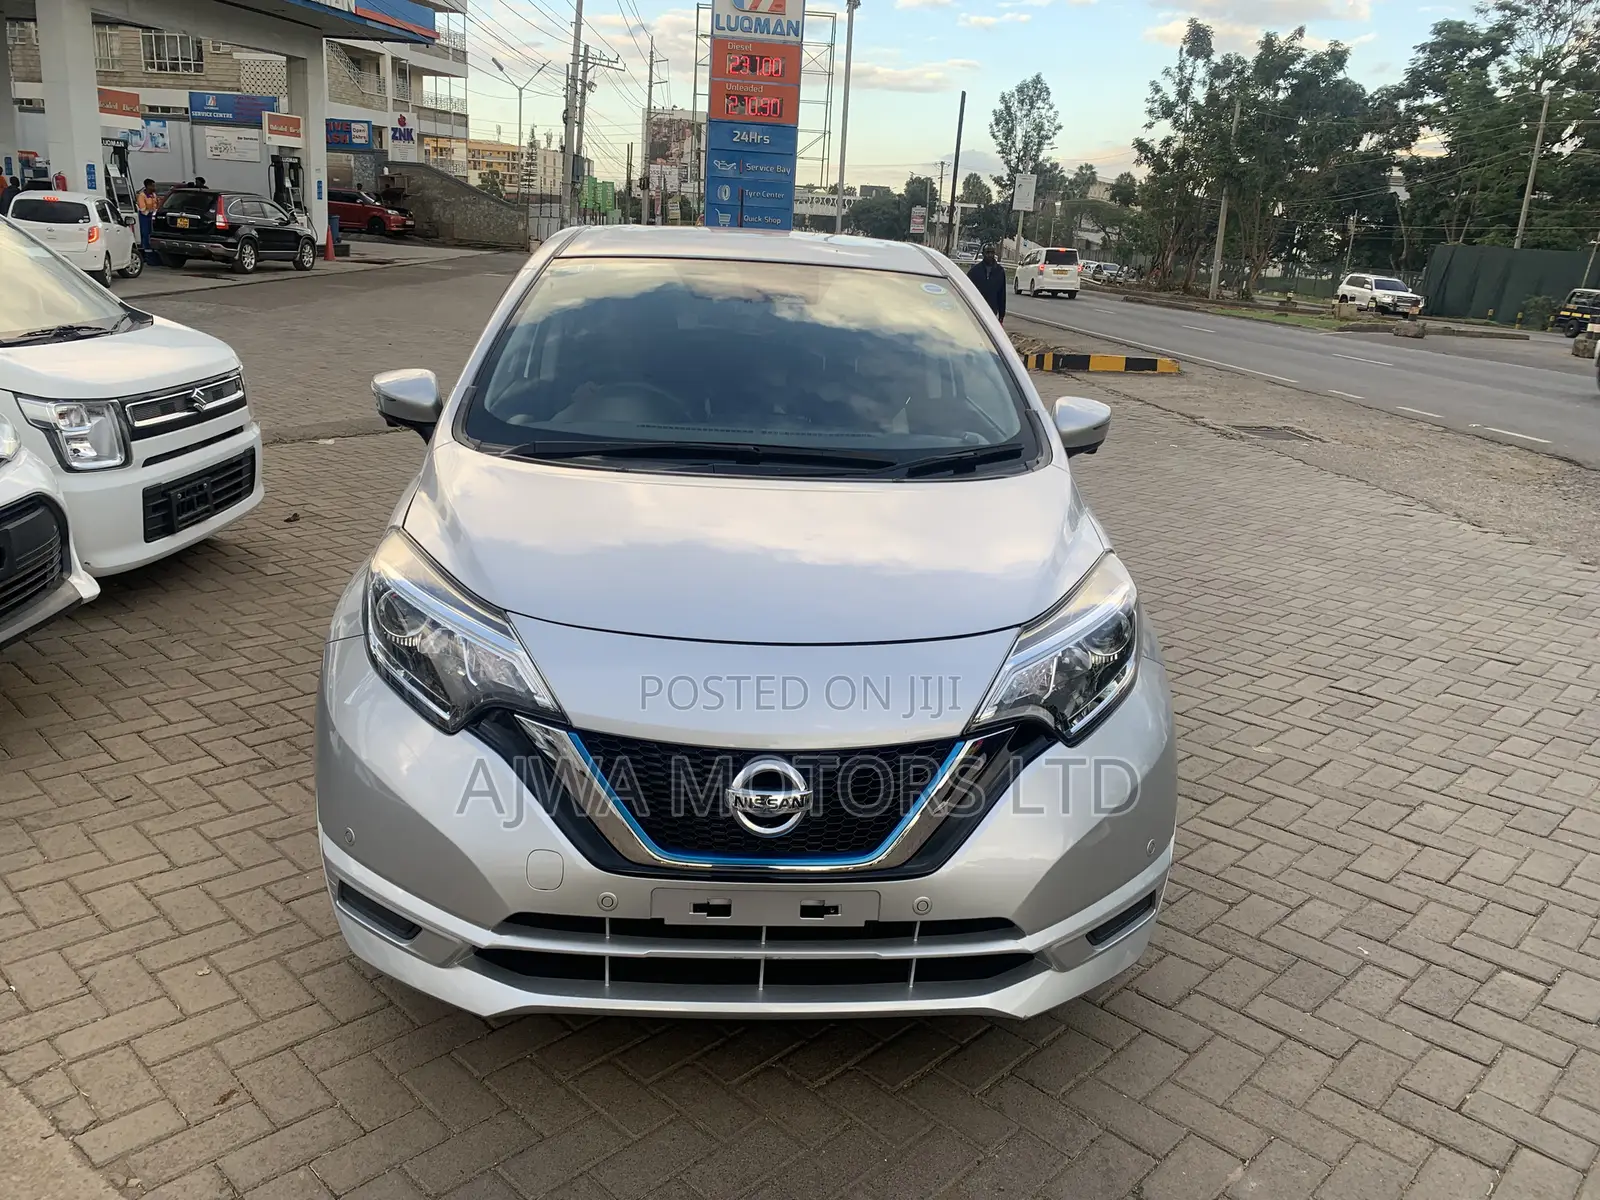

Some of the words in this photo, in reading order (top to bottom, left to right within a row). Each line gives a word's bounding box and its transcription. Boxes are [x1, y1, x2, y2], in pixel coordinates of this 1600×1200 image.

[715, 13, 800, 37] LUQMAN
[727, 42, 752, 51] Diesel
[725, 83, 763, 93] Unleaded
[391, 127, 415, 141] ZNK
[732, 130, 770, 144] 24Hrs
[746, 163, 775, 172] Service
[776, 165, 791, 175] Bay
[745, 189, 761, 198] Tyre
[761, 190, 785, 199] Center
[743, 214, 762, 222] Quick
[764, 216, 782, 225] Shop
[733, 794, 806, 810] NISSAN
